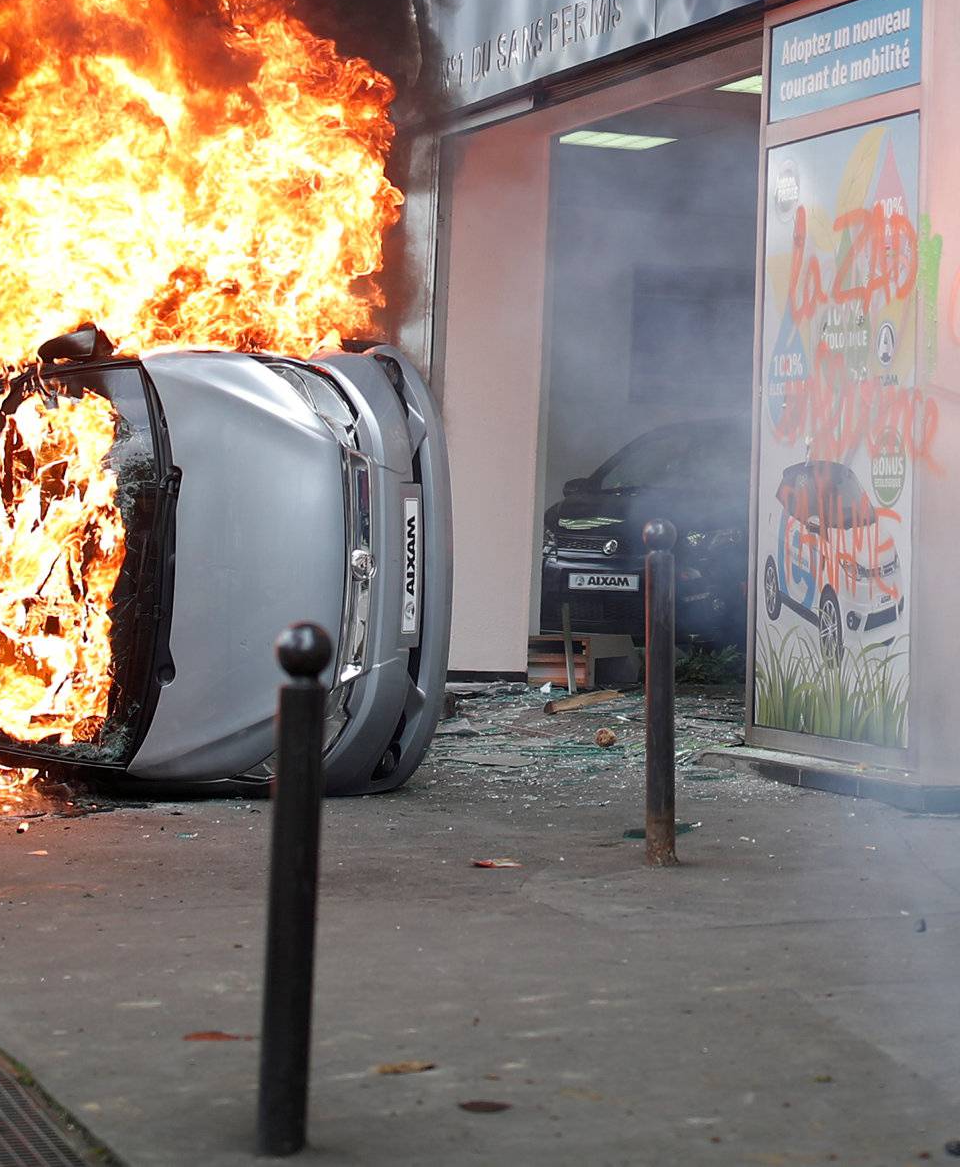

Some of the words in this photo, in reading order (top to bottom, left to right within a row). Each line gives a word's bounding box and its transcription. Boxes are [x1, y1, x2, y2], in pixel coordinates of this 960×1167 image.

[471, 39, 492, 83] DU
[497, 16, 544, 72] SANS
[781, 31, 832, 66] Adoptez
[834, 25, 850, 50] un
[853, 7, 911, 43] nouveau
[780, 64, 829, 102] courant
[831, 60, 848, 87] de
[850, 38, 911, 82] mobilité
[833, 200, 918, 314] ZAD
[872, 455, 904, 476] BONUS
[406, 515, 416, 596] AIXAM
[587, 576, 630, 587] AIXAM
